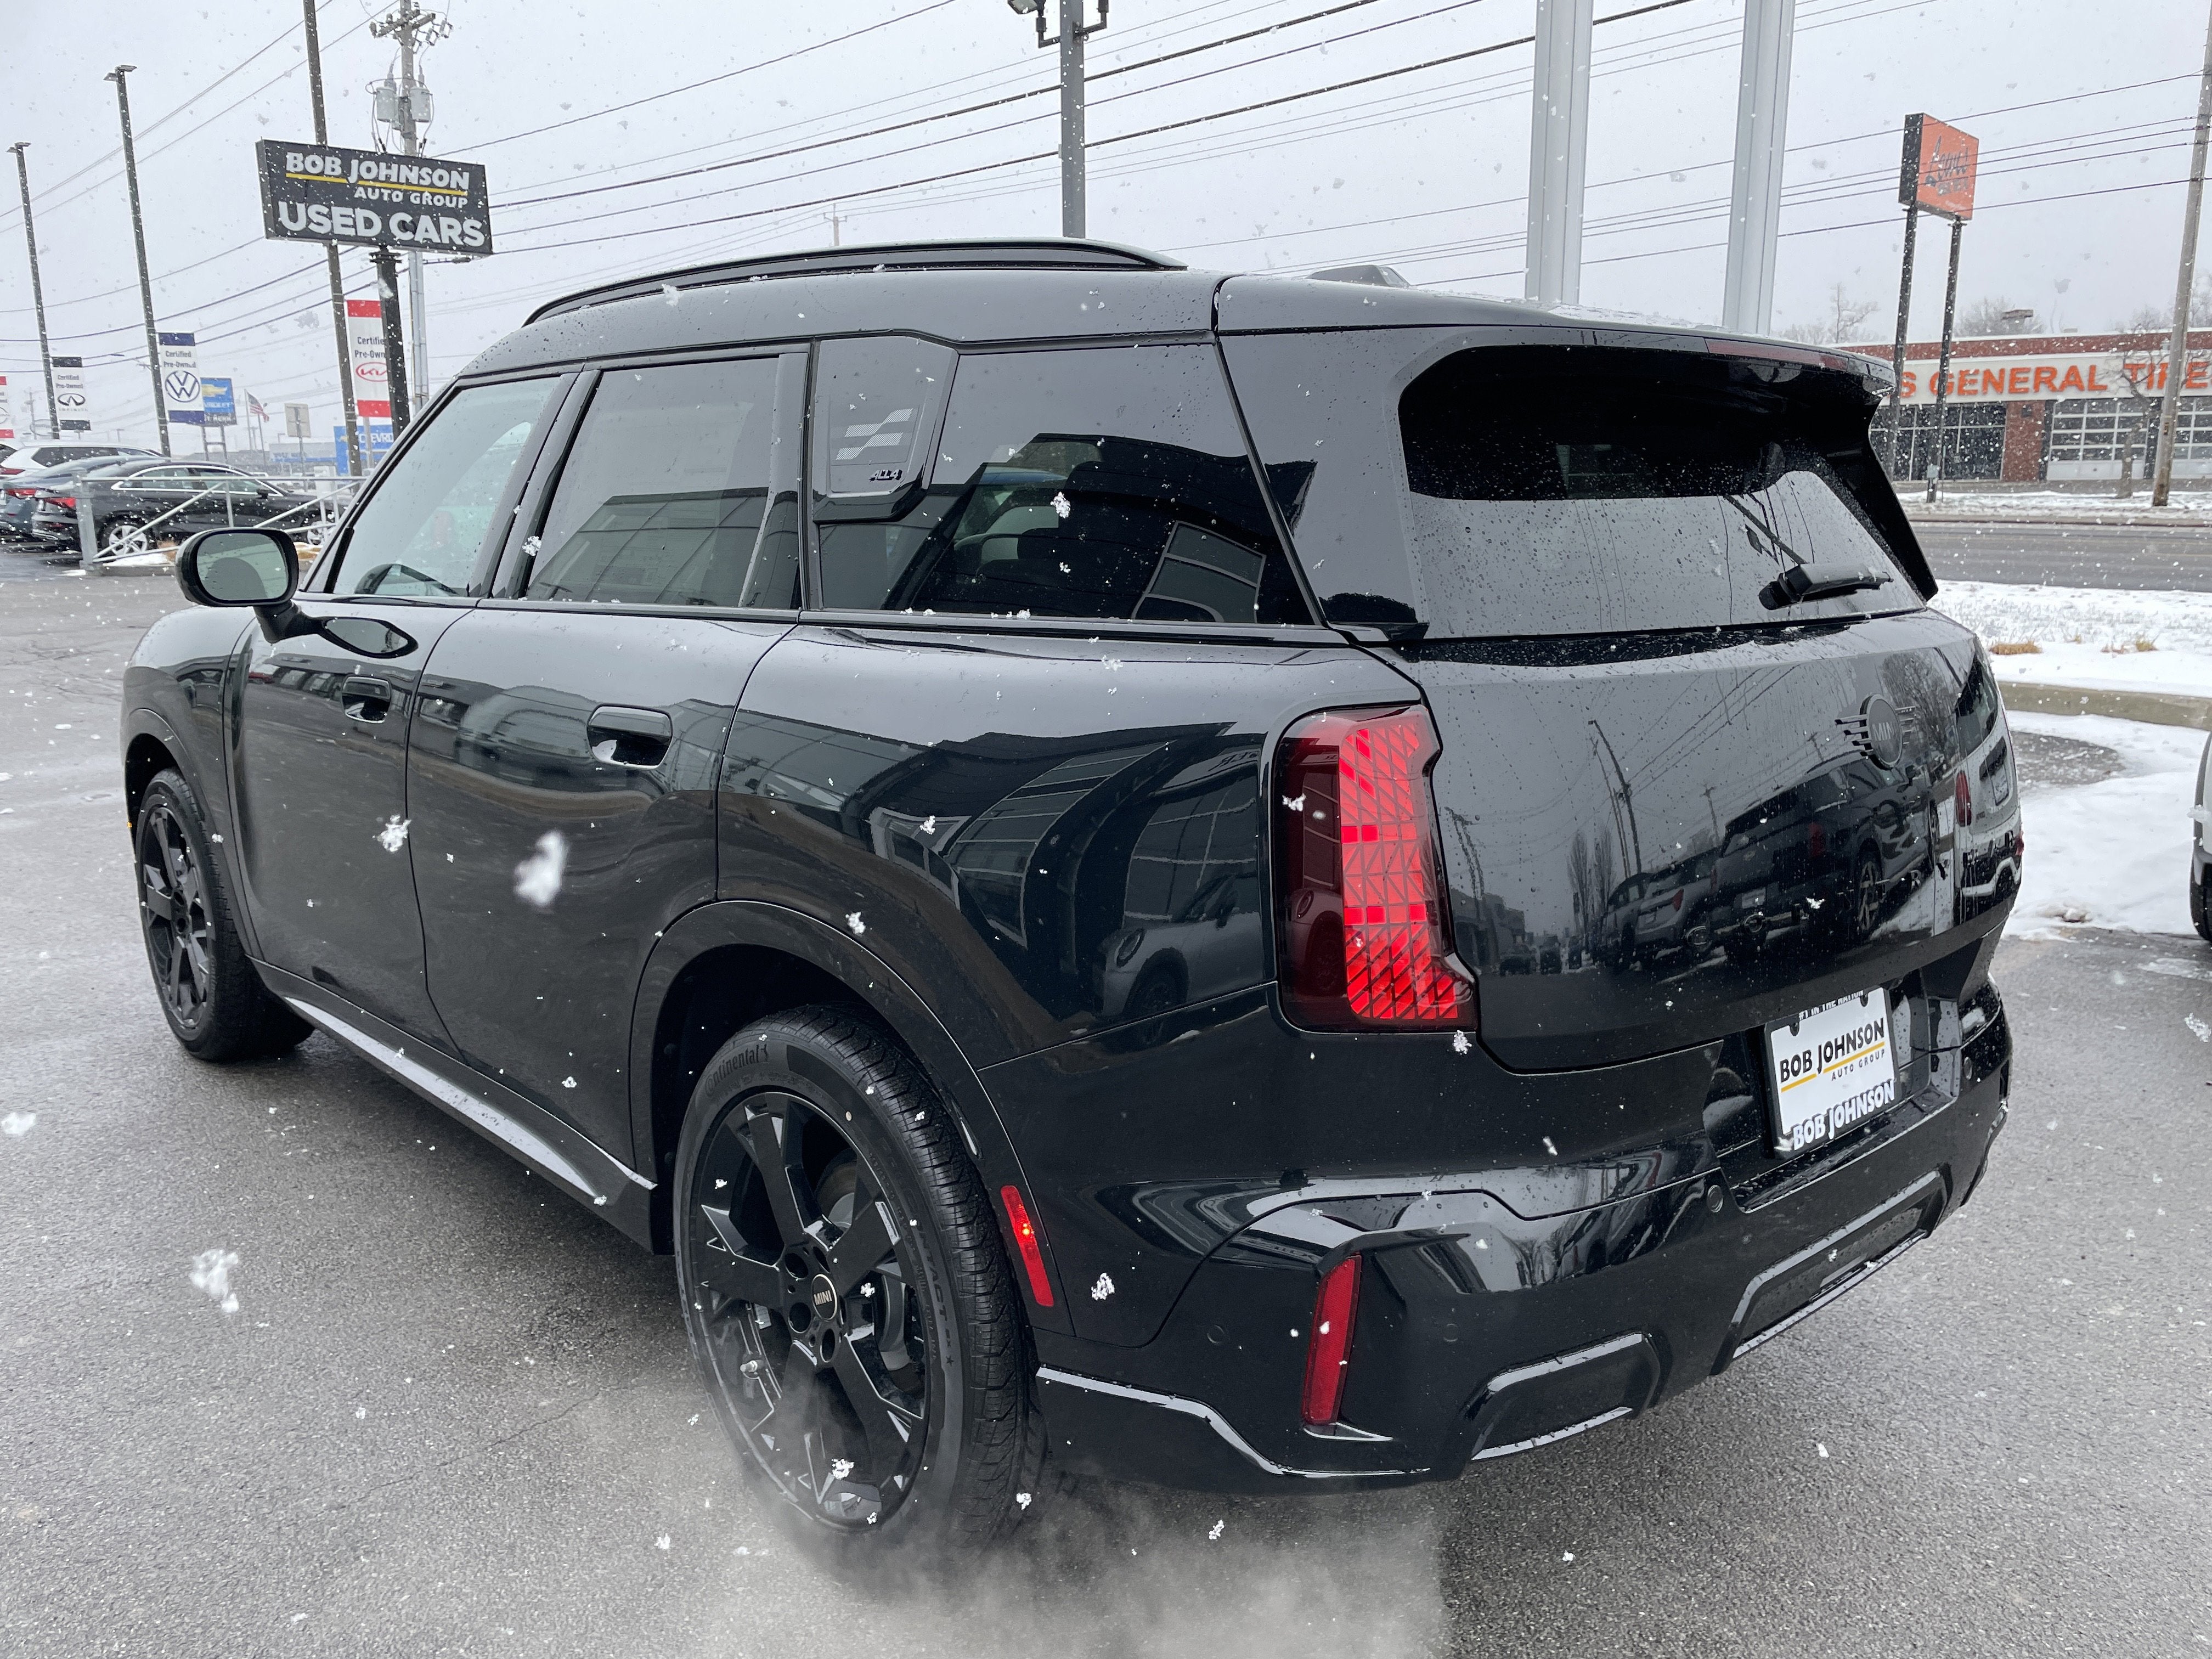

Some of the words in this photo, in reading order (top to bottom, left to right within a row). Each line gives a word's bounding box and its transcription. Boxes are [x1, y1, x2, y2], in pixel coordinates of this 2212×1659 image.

[286, 151, 342, 176] BOB
[348, 159, 470, 190] JOHNSON
[354, 187, 403, 202] AUTO
[409, 192, 469, 208] GROUP
[278, 200, 382, 237] USED
[388, 212, 485, 247] CARS
[1929, 364, 2108, 396] GENERAL
[358, 432, 394, 443] CEVRO
[870, 469, 901, 481] ALL4
[1780, 1049, 1813, 1083] BOB
[1817, 1017, 1884, 1074] JOHNSON
[1831, 1065, 1854, 1081] AUTO
[1859, 1048, 1885, 1068] GROUP
[705, 1044, 760, 1097] Continental
[1792, 1113, 1826, 1150] BOB
[1826, 1079, 1895, 1139] JOHNSON
[814, 1290, 832, 1305] MINI
